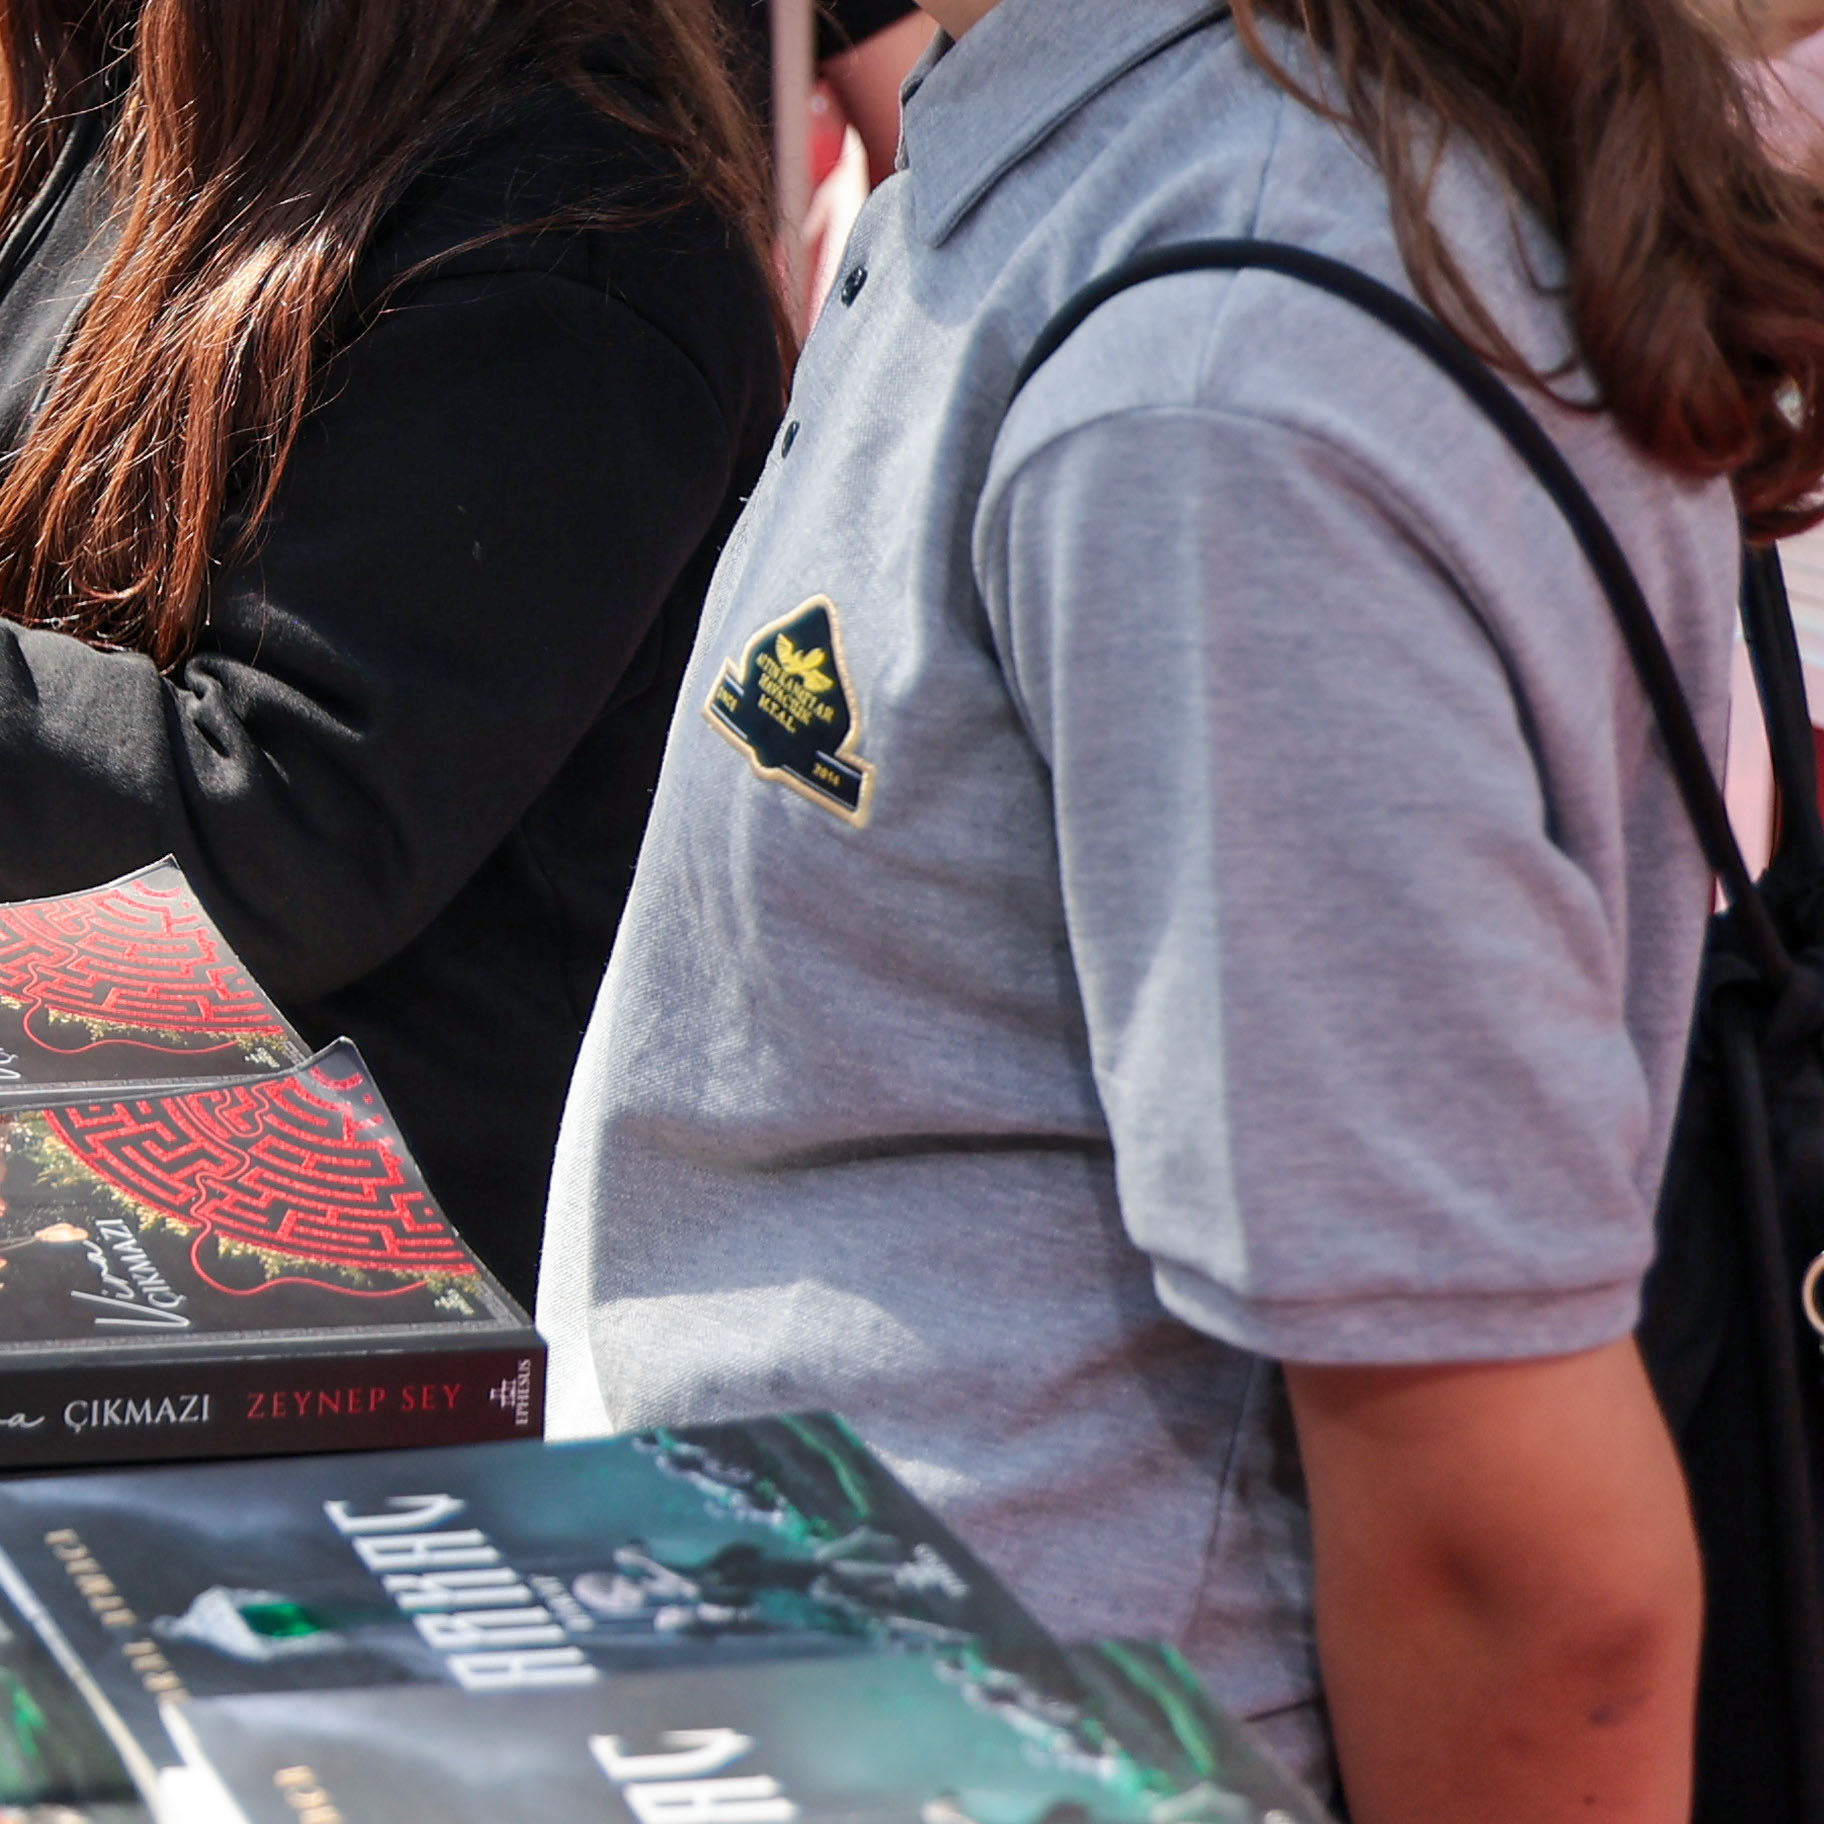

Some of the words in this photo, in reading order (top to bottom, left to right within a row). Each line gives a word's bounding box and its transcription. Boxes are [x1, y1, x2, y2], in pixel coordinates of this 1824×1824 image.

[63, 1393, 211, 1434] ÇIKMAZI
[246, 1387, 386, 1422] ZEYNEP
[399, 1383, 464, 1412] SEY
[514, 1357, 533, 1427] EPHESUS
